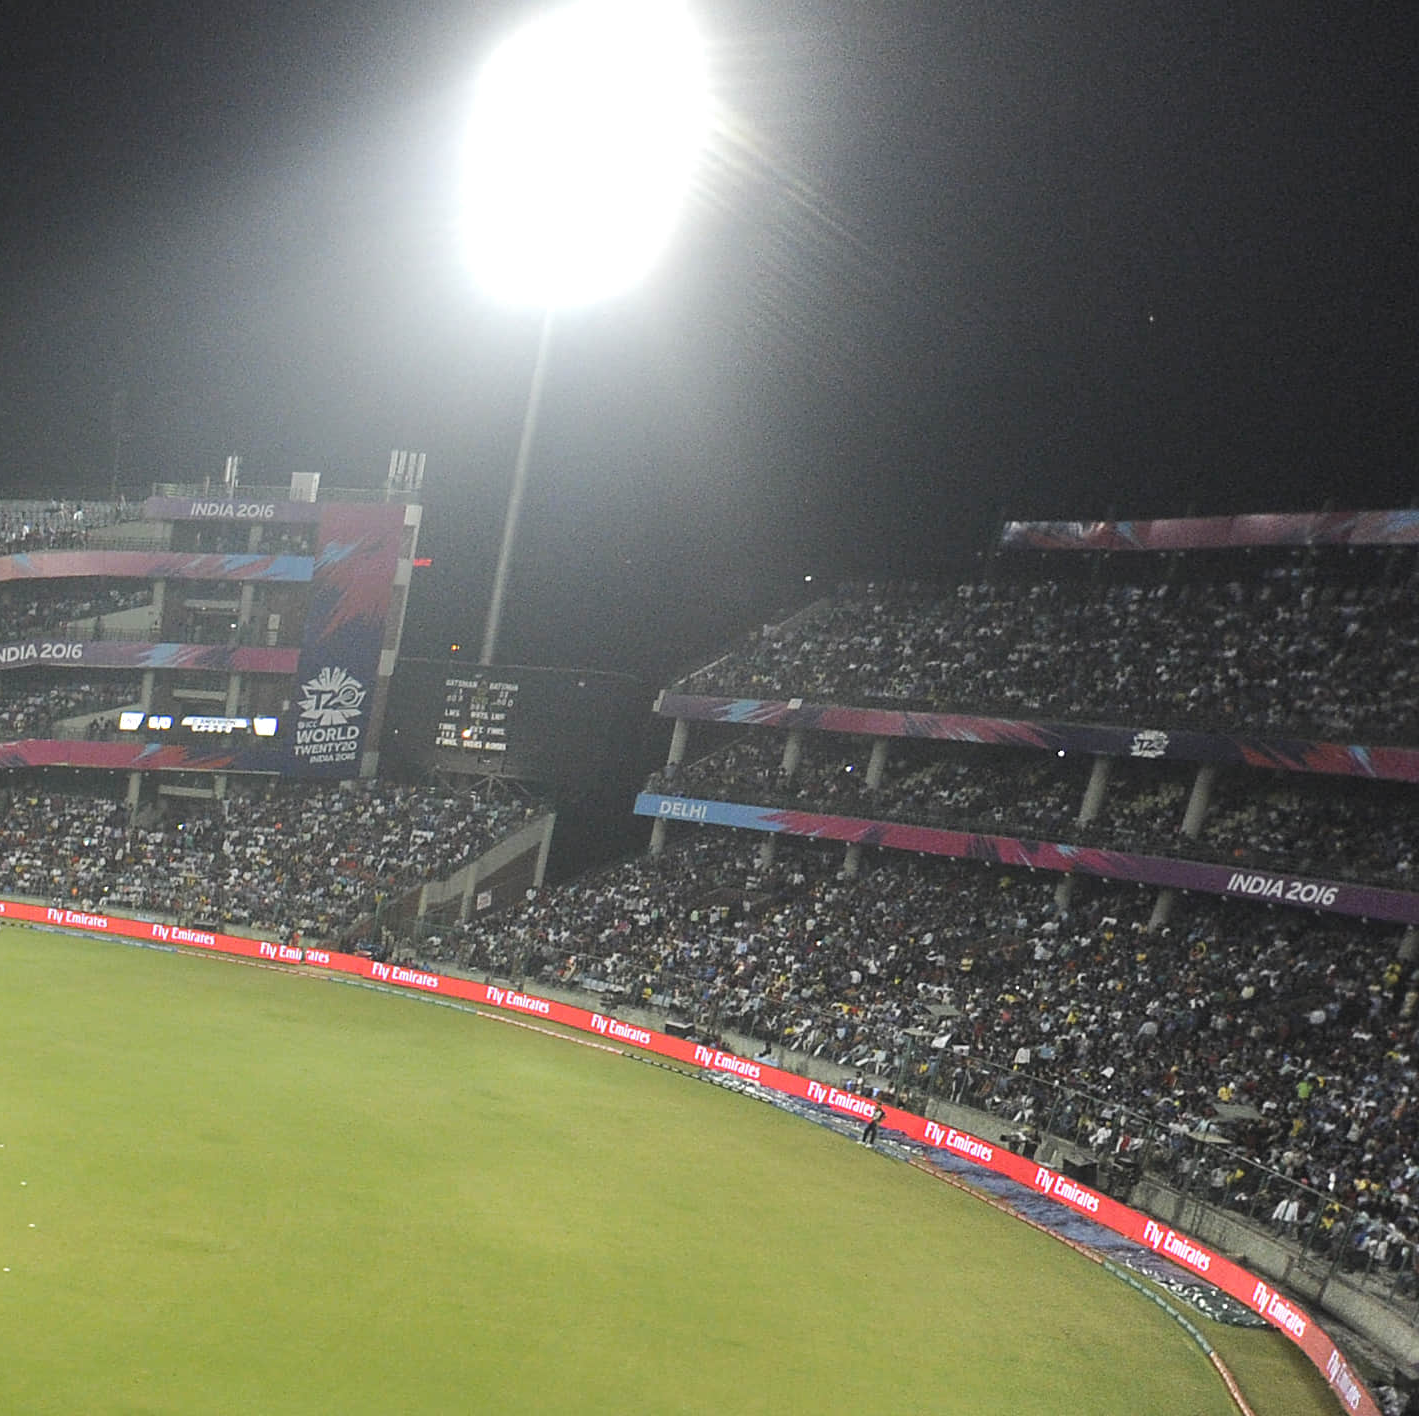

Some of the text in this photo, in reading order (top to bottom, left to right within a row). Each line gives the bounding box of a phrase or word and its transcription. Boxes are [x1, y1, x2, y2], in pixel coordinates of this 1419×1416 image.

[189, 502, 275, 519] INDIA 2016
[39, 641, 82, 660] 2016
[297, 726, 360, 744] WORLD
[295, 741, 358, 756] TWENTY20
[662, 801, 707, 820] DELHI
[1227, 873, 1338, 905] INDIA 2016
[47, 908, 108, 928] Fly Emirates
[152, 924, 215, 946] Fly Emirates
[260, 942, 276, 959] Fly
[372, 962, 439, 988] Fly Emirates
[486, 987, 550, 1014] Fly Emirates
[591, 1014, 651, 1045] Fly Emirates
[694, 1046, 761, 1079] Fly Emirates
[807, 1081, 876, 1118] Fly Emirates
[924, 1121, 993, 1162] Fly Emirates
[1035, 1168, 1100, 1212] Fly Emirates
[1144, 1220, 1212, 1271] Fly Emirates
[1253, 1281, 1307, 1338] Fly Emirates
